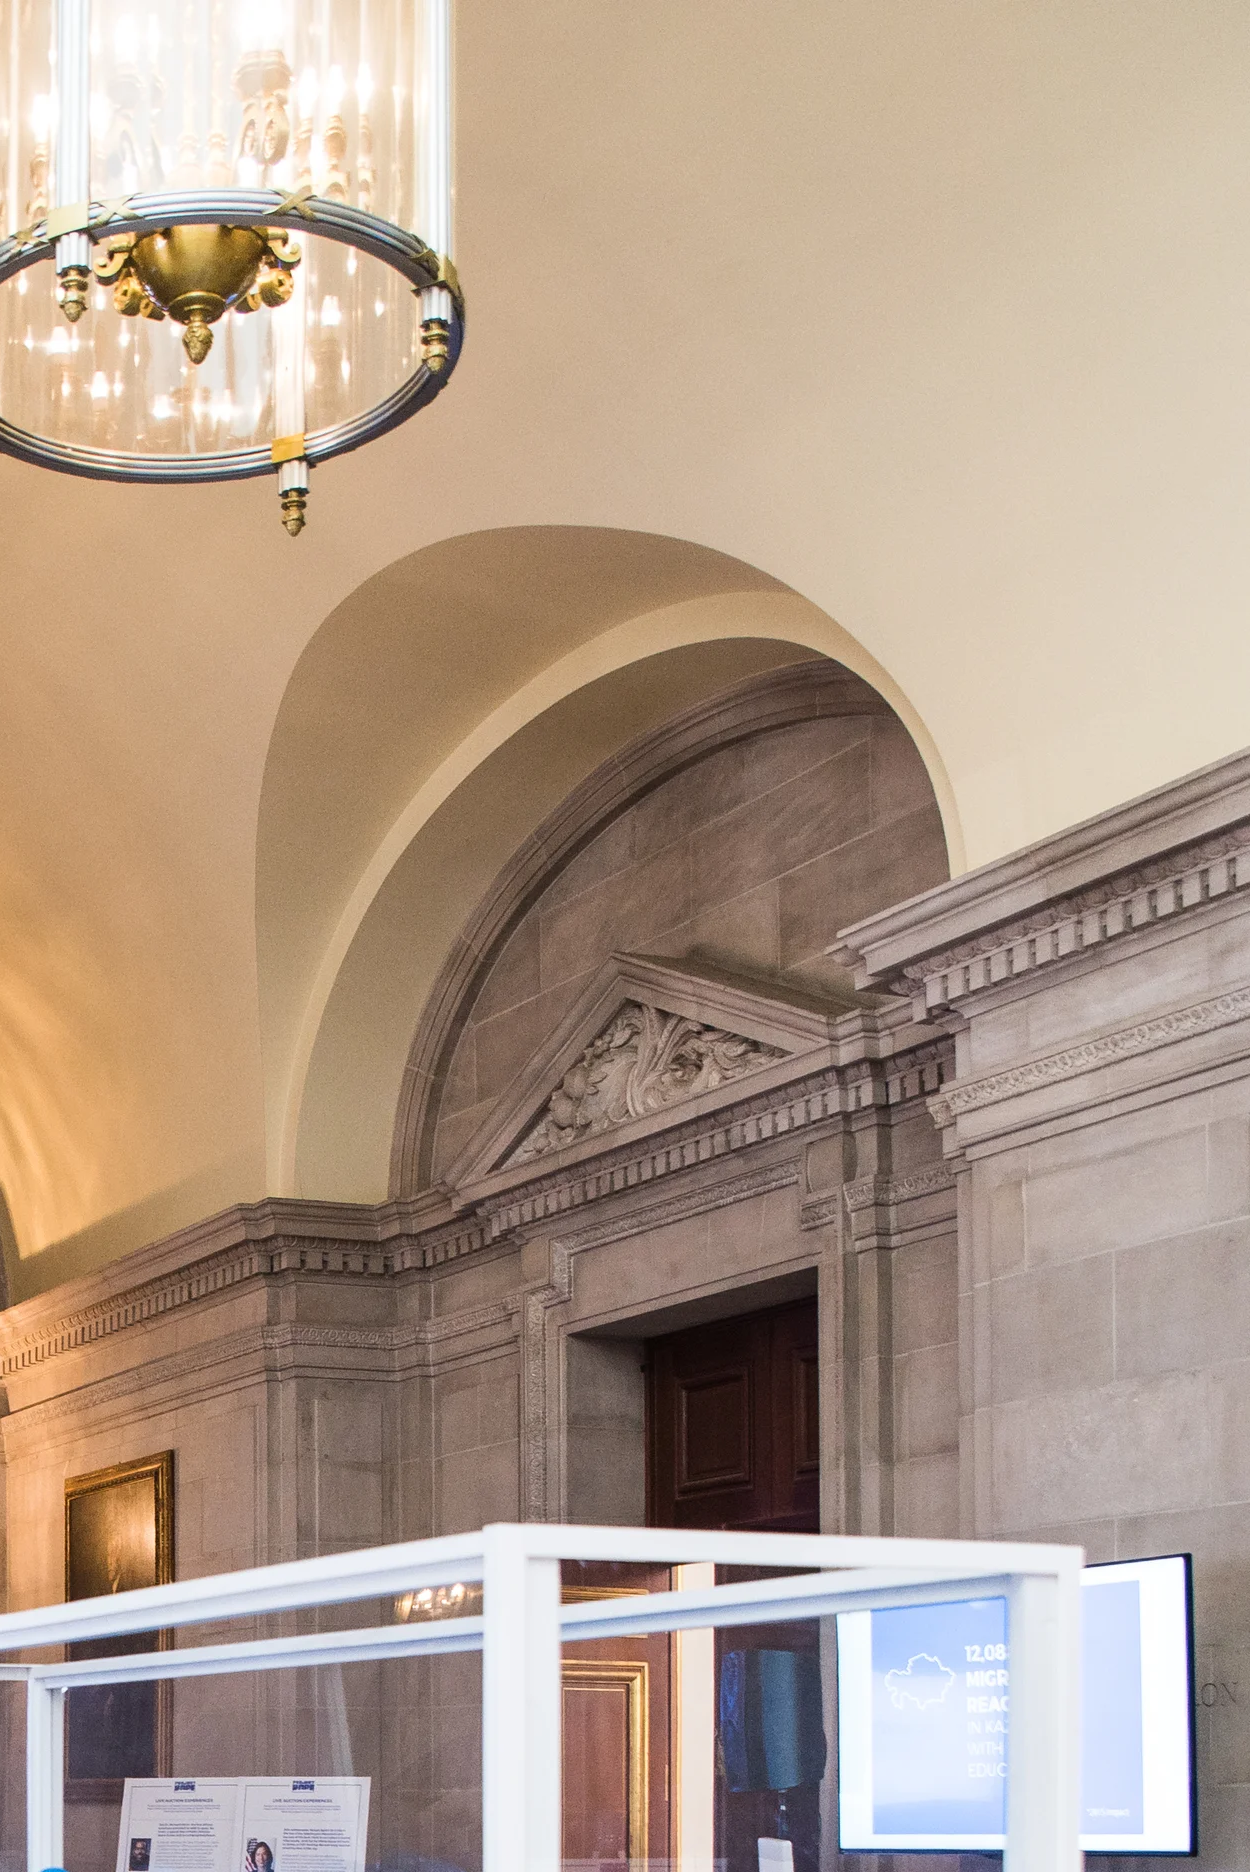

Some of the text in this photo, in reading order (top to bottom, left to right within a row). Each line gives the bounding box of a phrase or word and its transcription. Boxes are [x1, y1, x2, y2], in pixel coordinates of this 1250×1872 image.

[964, 1643, 1009, 1664] 12,08
[965, 1669, 1010, 1688] MIGR
[968, 1696, 1010, 1713] REAC
[968, 1741, 1004, 1756] WITH
[968, 1762, 1008, 1778] EDUC
